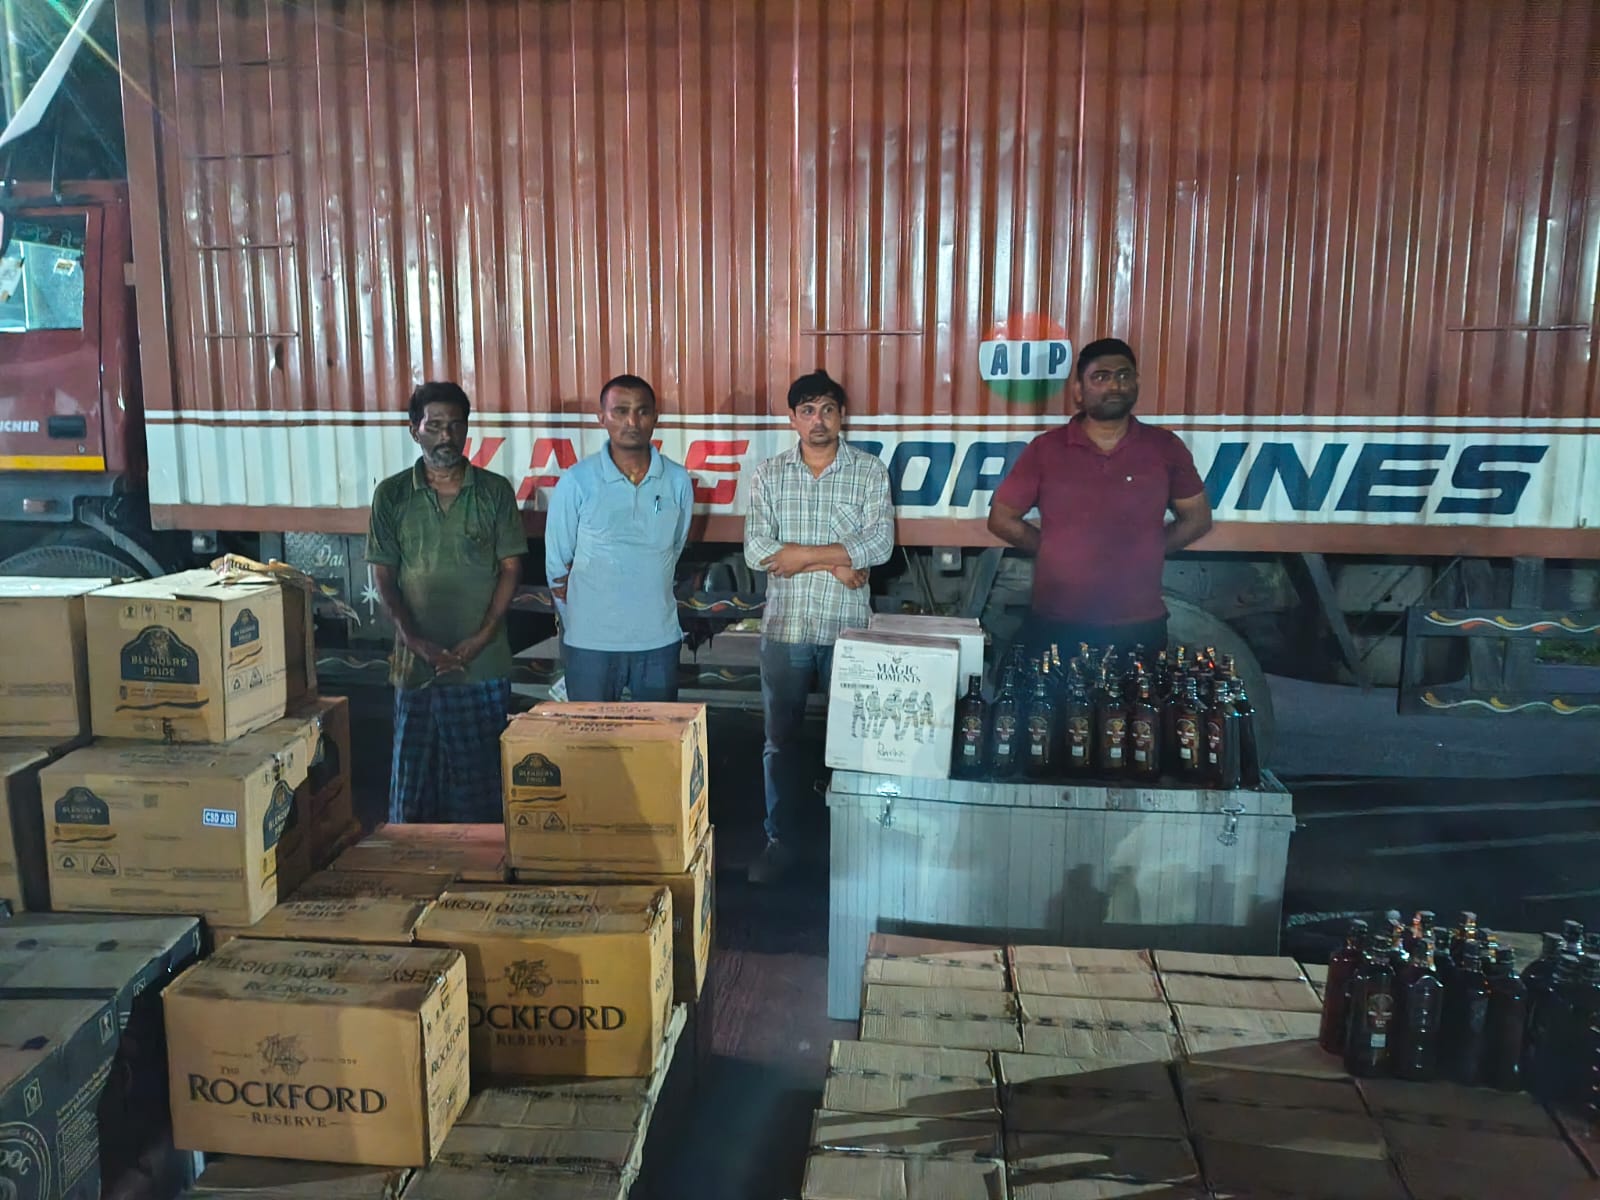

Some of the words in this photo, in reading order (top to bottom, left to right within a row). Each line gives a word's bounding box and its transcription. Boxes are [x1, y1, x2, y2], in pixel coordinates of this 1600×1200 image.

[990, 342, 1067, 375] AIP
[143, 666, 176, 677] PRIDE
[877, 663, 919, 676] MAGIC
[440, 898, 492, 912] MODI
[469, 1003, 627, 1032] OCKFORD
[187, 1073, 388, 1115] ROCKFORD
[251, 1111, 327, 1129] RESERVE
